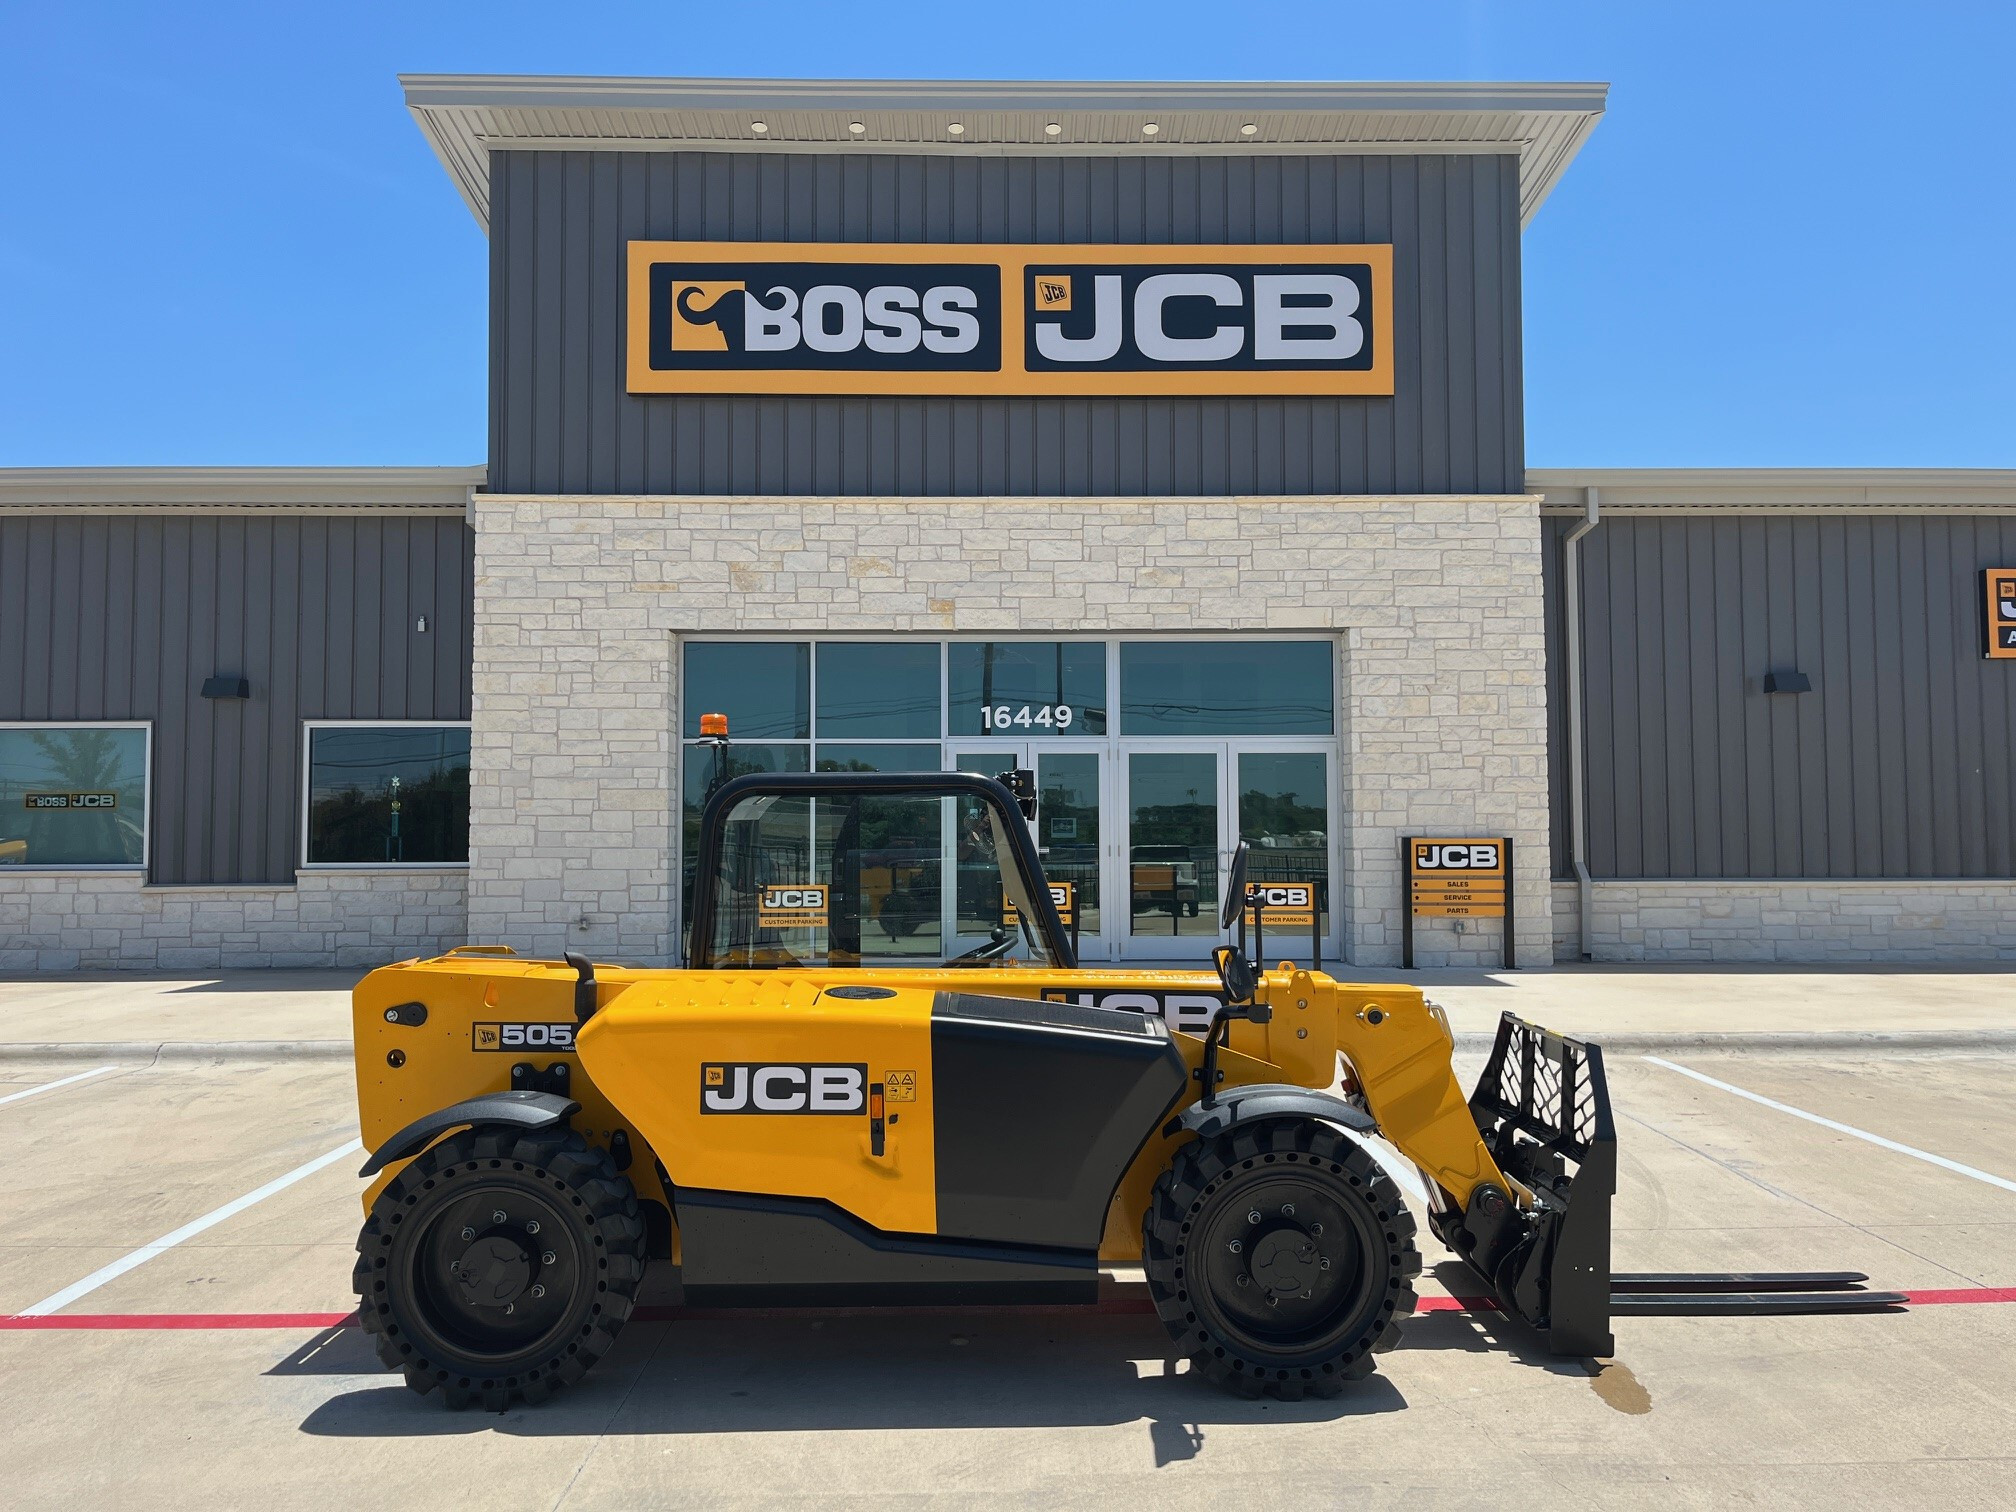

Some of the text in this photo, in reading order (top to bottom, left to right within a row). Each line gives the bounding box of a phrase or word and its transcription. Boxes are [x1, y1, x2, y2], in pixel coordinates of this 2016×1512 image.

[1044, 284, 1066, 302] JCB
[744, 273, 1364, 362] BOSS JCB
[980, 705, 1073, 729] 16449
[36, 795, 114, 807] BOSS JCB
[1418, 845, 1497, 868] JCB
[765, 890, 823, 907] JCB
[1261, 888, 1308, 905] CB
[481, 1030, 496, 1043] JCB
[502, 1024, 576, 1045] 505
[705, 1066, 863, 1111] JCB
